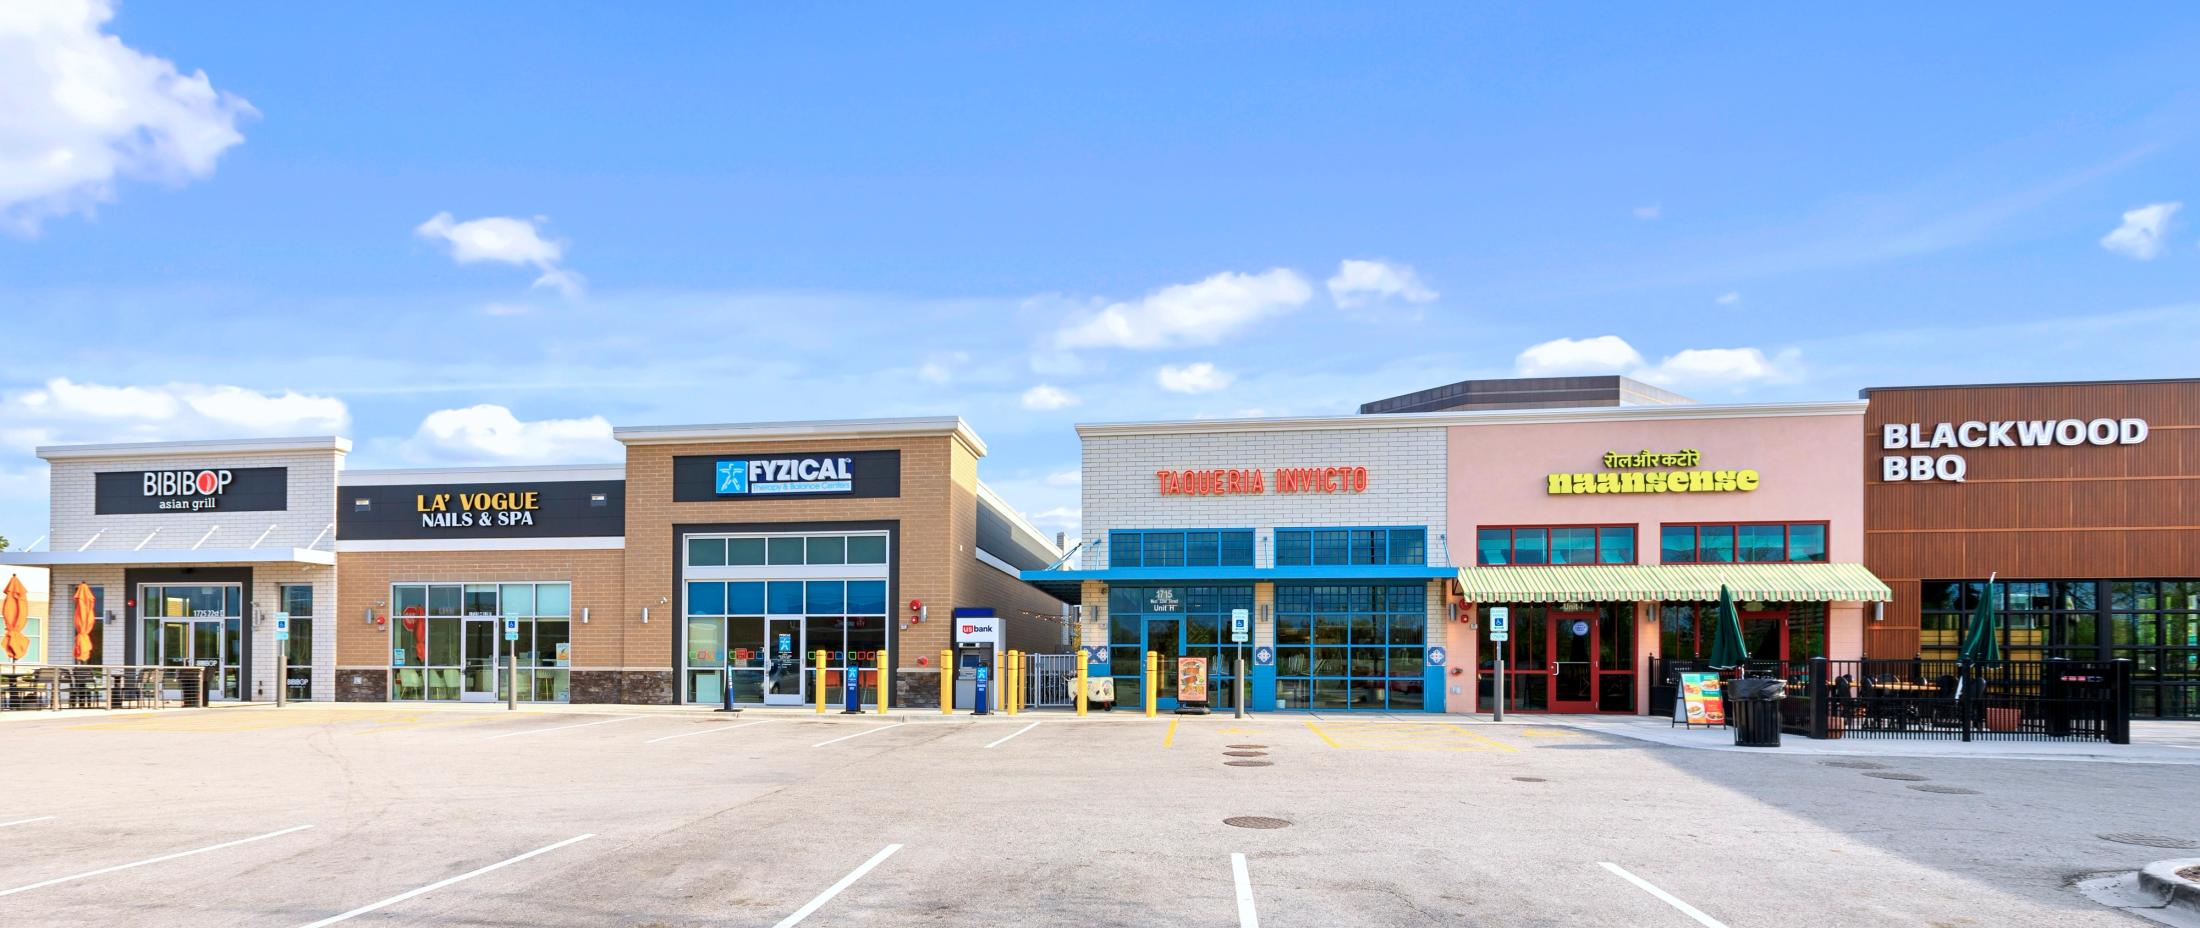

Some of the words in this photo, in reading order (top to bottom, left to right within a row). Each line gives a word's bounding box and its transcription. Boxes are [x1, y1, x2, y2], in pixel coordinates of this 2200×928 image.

[1883, 418, 2149, 449] BLACKWOOD
[749, 458, 852, 481] FYZICAL
[1883, 454, 1967, 483] BBQ
[143, 470, 232, 496] BIBIBOP
[1156, 468, 1264, 496] TAQUERIA
[1275, 466, 1369, 493] INVICTO
[1548, 469, 1760, 495] naansense
[159, 499, 190, 509] asian
[192, 497, 216, 511] grill
[459, 491, 539, 510] VOGUE
[422, 512, 474, 528] NAILS
[478, 512, 492, 527] &
[498, 511, 534, 526] SPA
[1156, 589, 1173, 599] 1715
